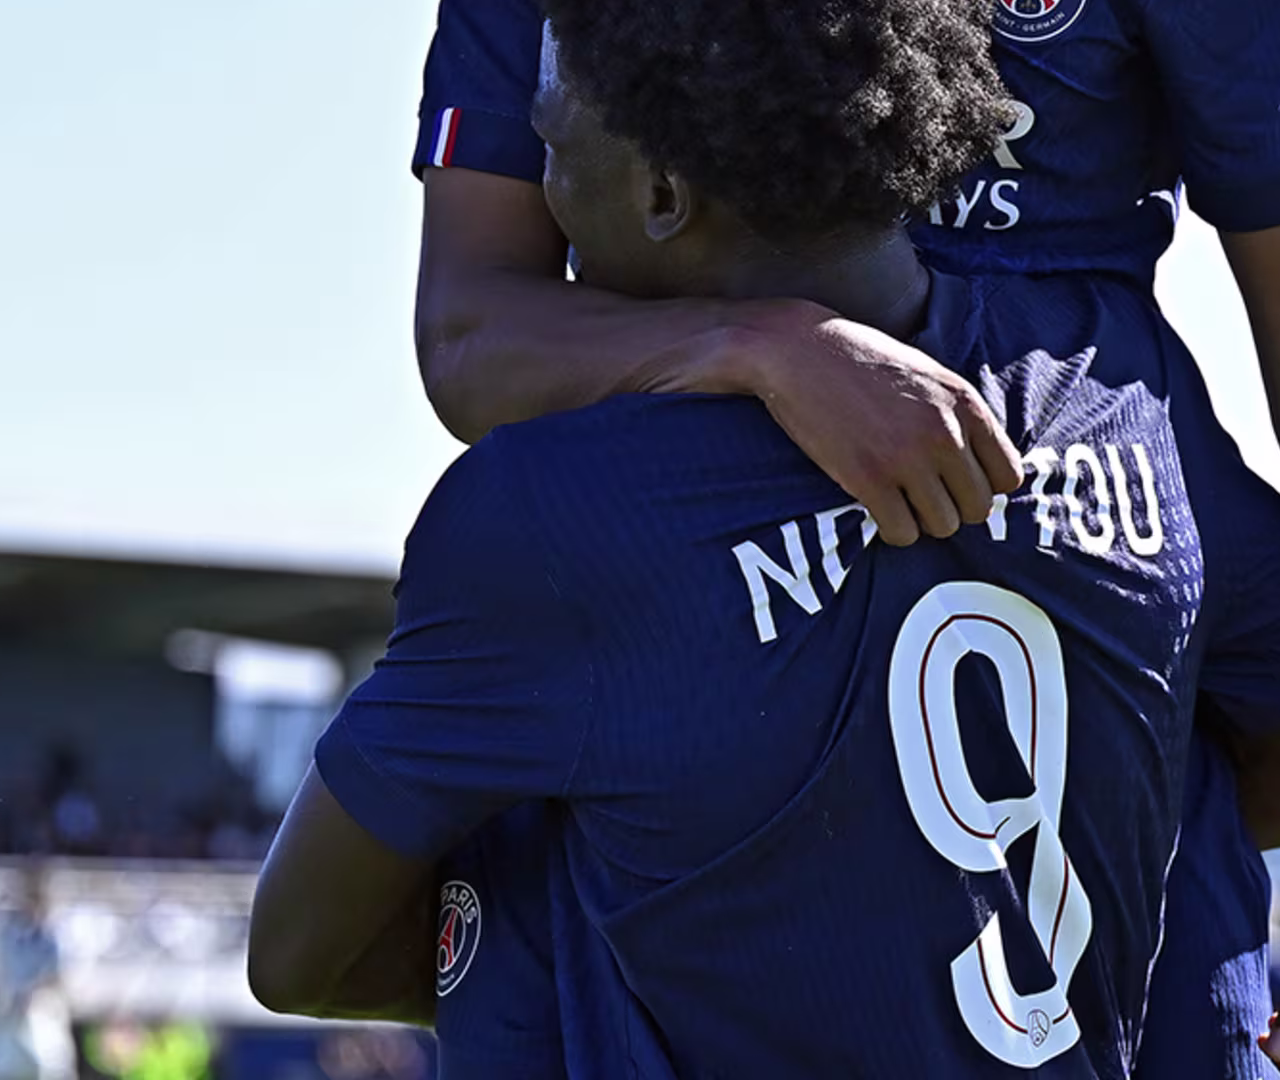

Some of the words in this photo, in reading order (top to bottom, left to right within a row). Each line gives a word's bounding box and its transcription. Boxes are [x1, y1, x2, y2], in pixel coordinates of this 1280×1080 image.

[731, 443, 1163, 643] NDTOU
[440, 887, 478, 924] PARIS
[887, 581, 1093, 1068] 9
